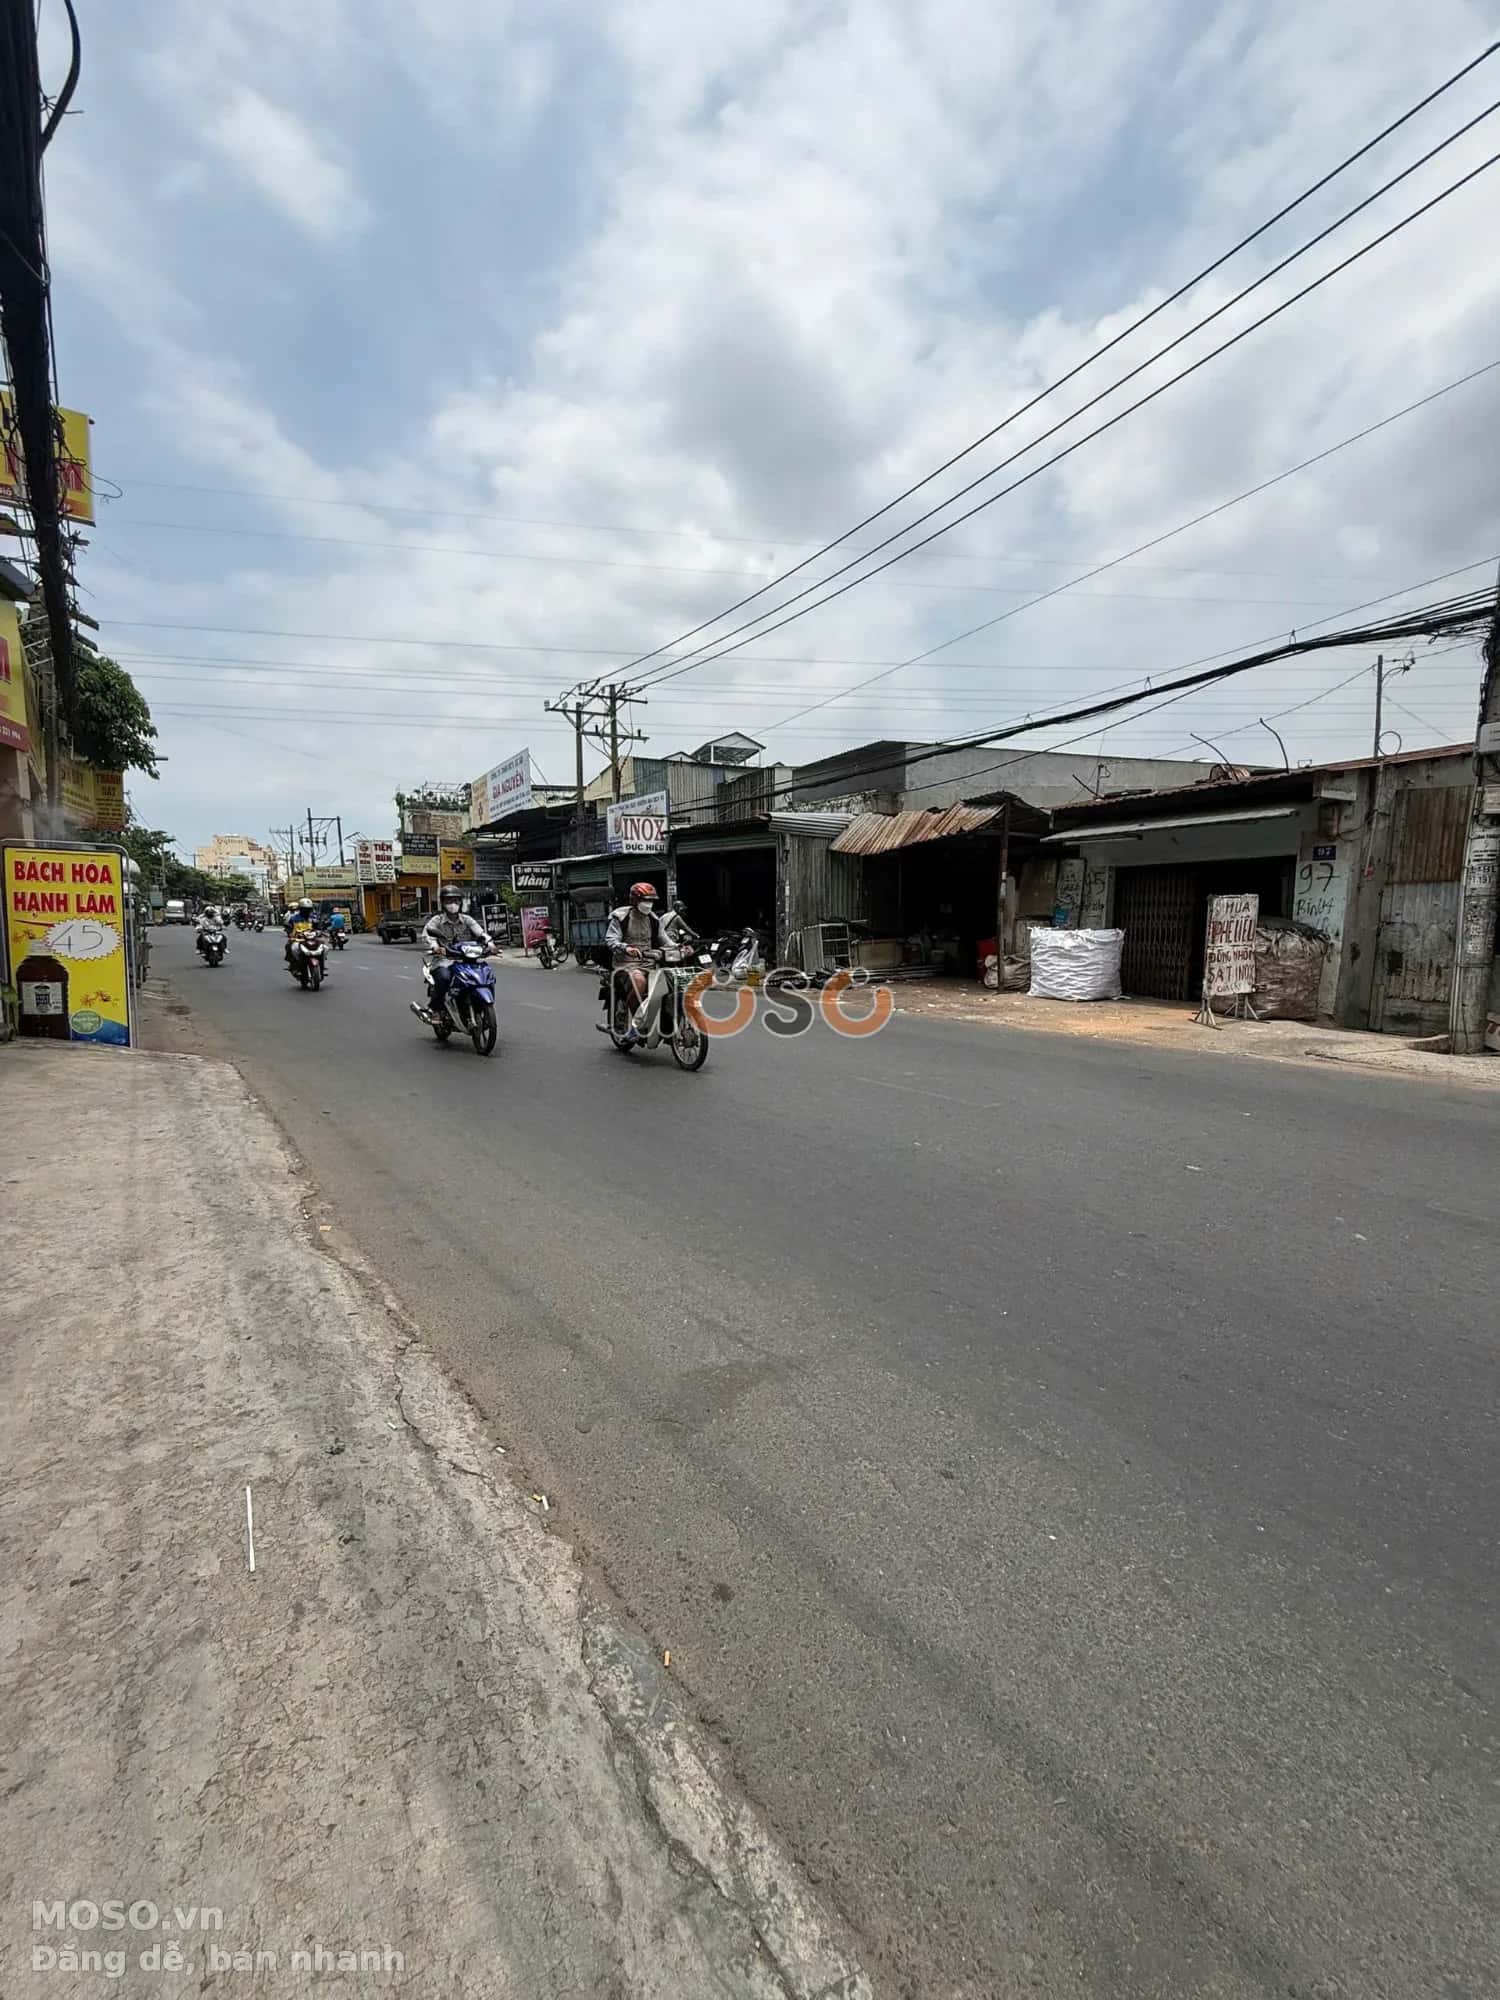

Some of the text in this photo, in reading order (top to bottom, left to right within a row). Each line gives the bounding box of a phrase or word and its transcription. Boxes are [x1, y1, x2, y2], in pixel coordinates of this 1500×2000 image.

[623, 818, 665, 841] INOX
[1317, 848, 1332, 856] 97
[1297, 863, 1341, 895] 97
[13, 890, 115, 916] HẠNH LÂM
[1226, 902, 1250, 914] MUA
[50, 924, 104, 953] 45
